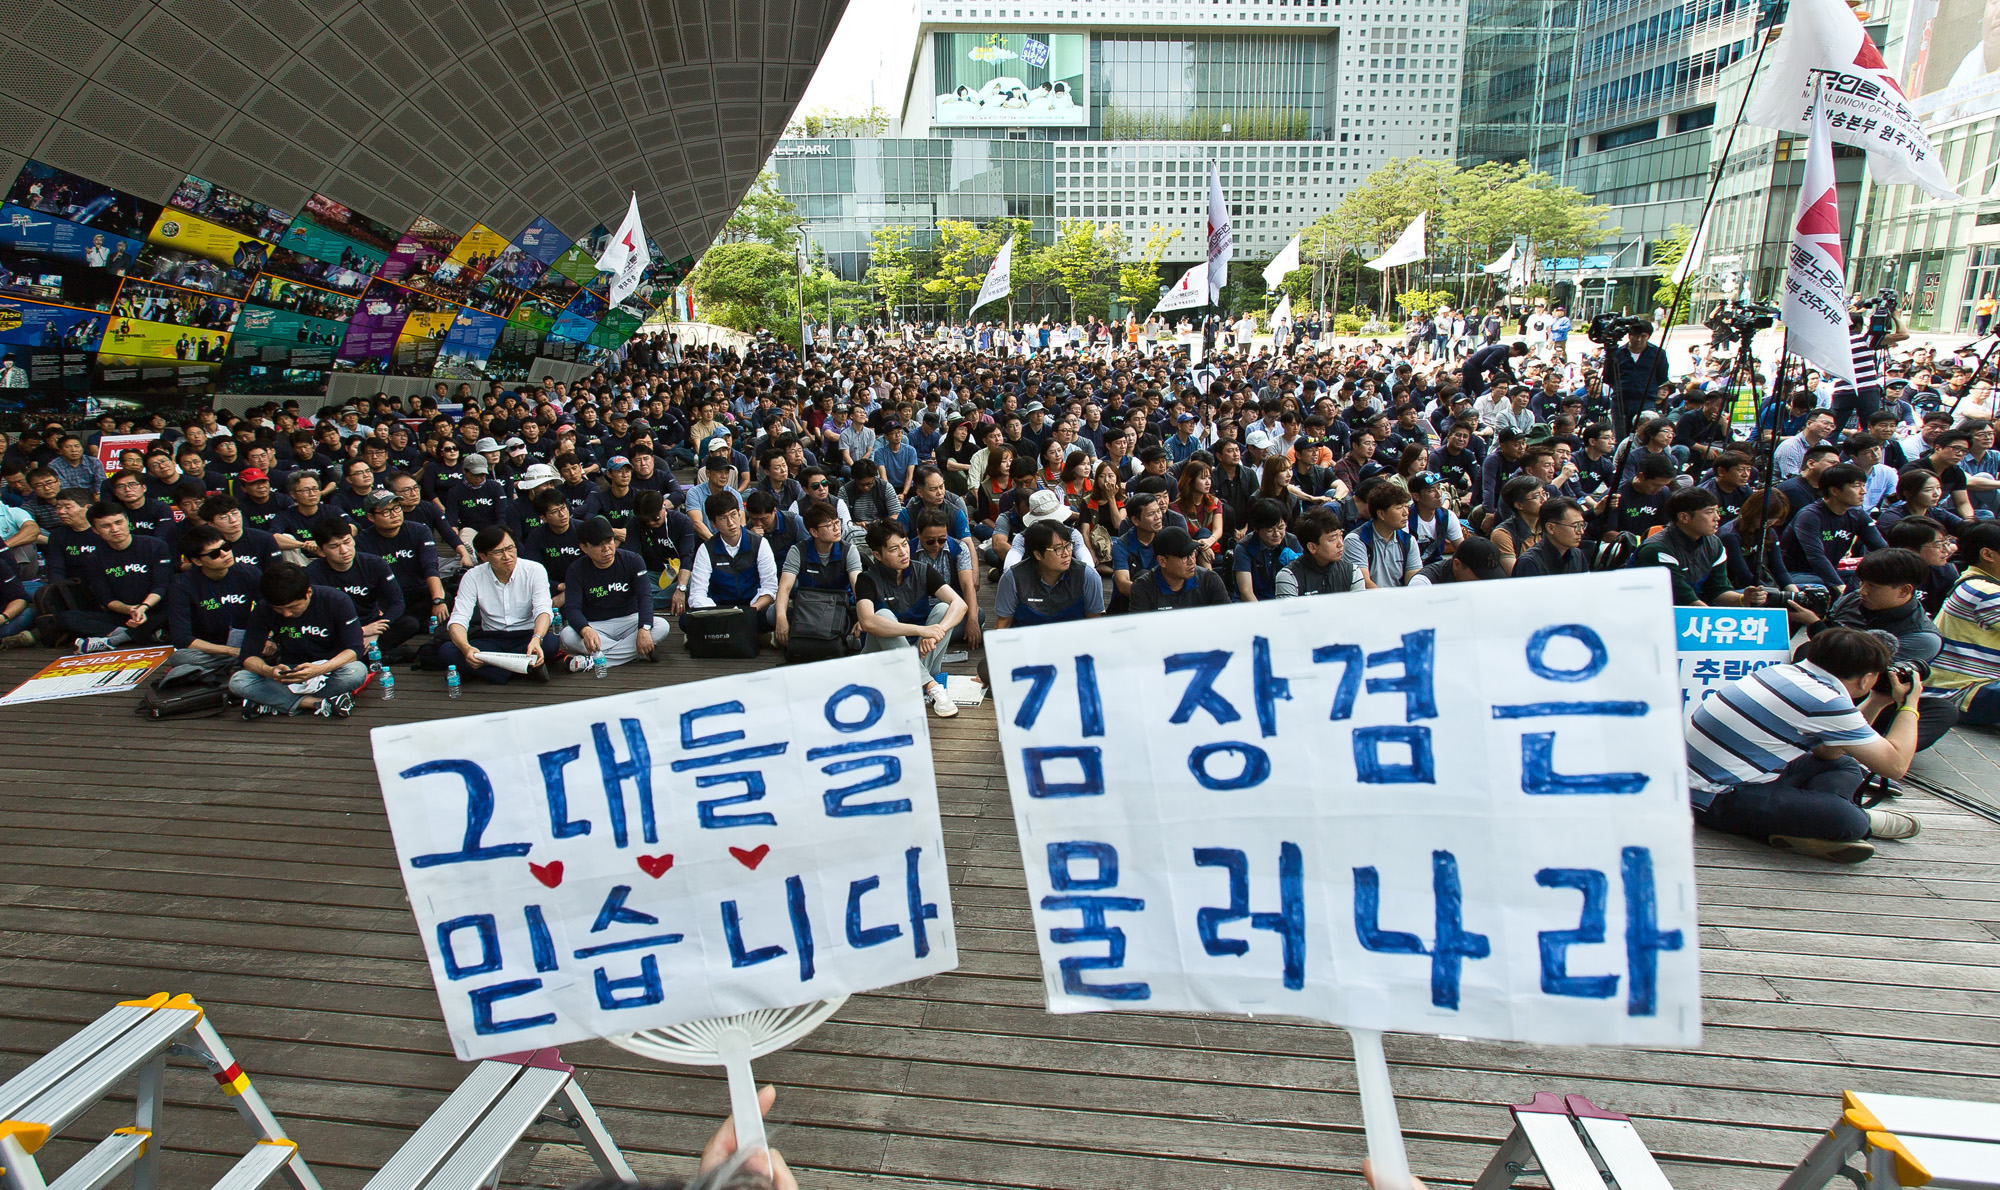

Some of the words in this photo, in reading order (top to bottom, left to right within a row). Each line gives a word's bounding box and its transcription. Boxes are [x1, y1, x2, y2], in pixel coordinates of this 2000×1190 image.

[1835, 94, 1867, 109] UNION
[1868, 104, 1882, 115] OF
[797, 144, 831, 155] PARK
[1879, 125, 1925, 162] 원주지부
[1798, 289, 1842, 325] 전주지부
[476, 498, 493, 506] MBC
[1639, 505, 1658, 516] MBC
[136, 521, 155, 530] MBC
[395, 550, 415, 559] MBC
[560, 547, 581, 556] MBC
[235, 555, 259, 565] MBC
[105, 566, 122, 575] SAVE
[124, 563, 149, 574] MBC
[344, 585, 369, 596] MBC
[589, 586, 604, 594] SAVE
[597, 590, 609, 598] OUR
[608, 582, 630, 593] MBC
[220, 594, 247, 605] MBC
[280, 626, 296, 634] SAVE
[289, 631, 302, 639] OUR
[301, 625, 330, 638] MBC
[1682, 616, 1769, 645] 사유화
[1011, 623, 1650, 798] 김장겸은
[399, 684, 914, 869] 그대들을
[1041, 841, 1684, 1017] 물러나라
[436, 845, 939, 1035] 믿습니다
